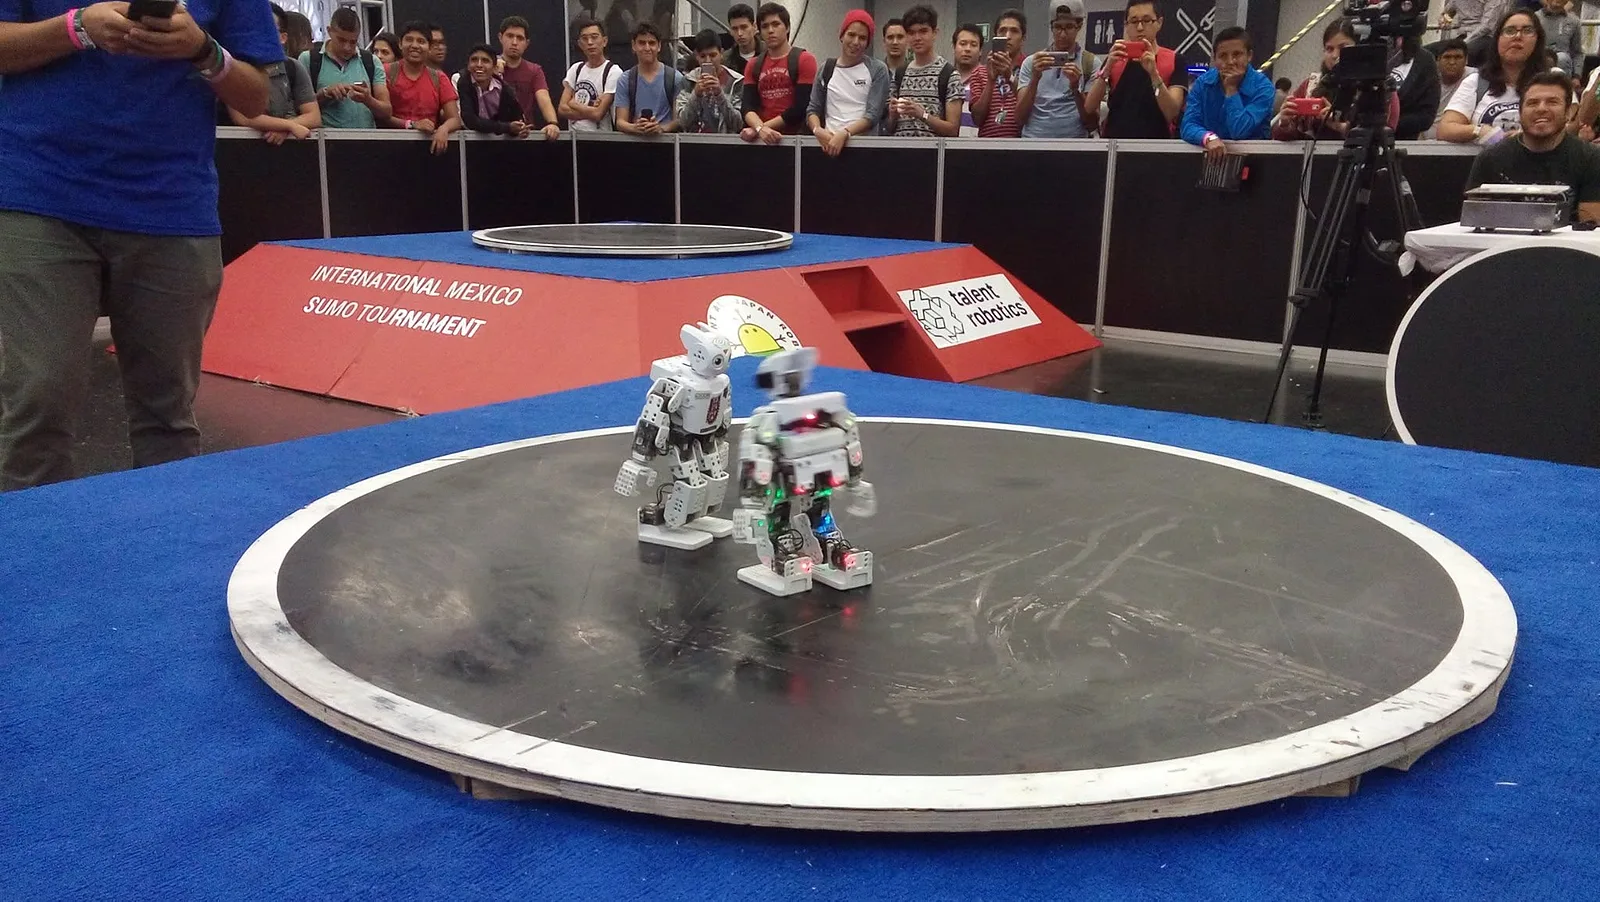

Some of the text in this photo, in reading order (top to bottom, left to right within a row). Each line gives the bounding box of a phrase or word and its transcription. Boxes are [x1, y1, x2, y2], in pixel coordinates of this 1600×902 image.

[310, 265, 523, 306] INTERNATIONAL MEXICO
[948, 283, 1000, 307] talent
[303, 296, 487, 338] SUMO TOURNAMENT
[966, 301, 1028, 328] robotics
